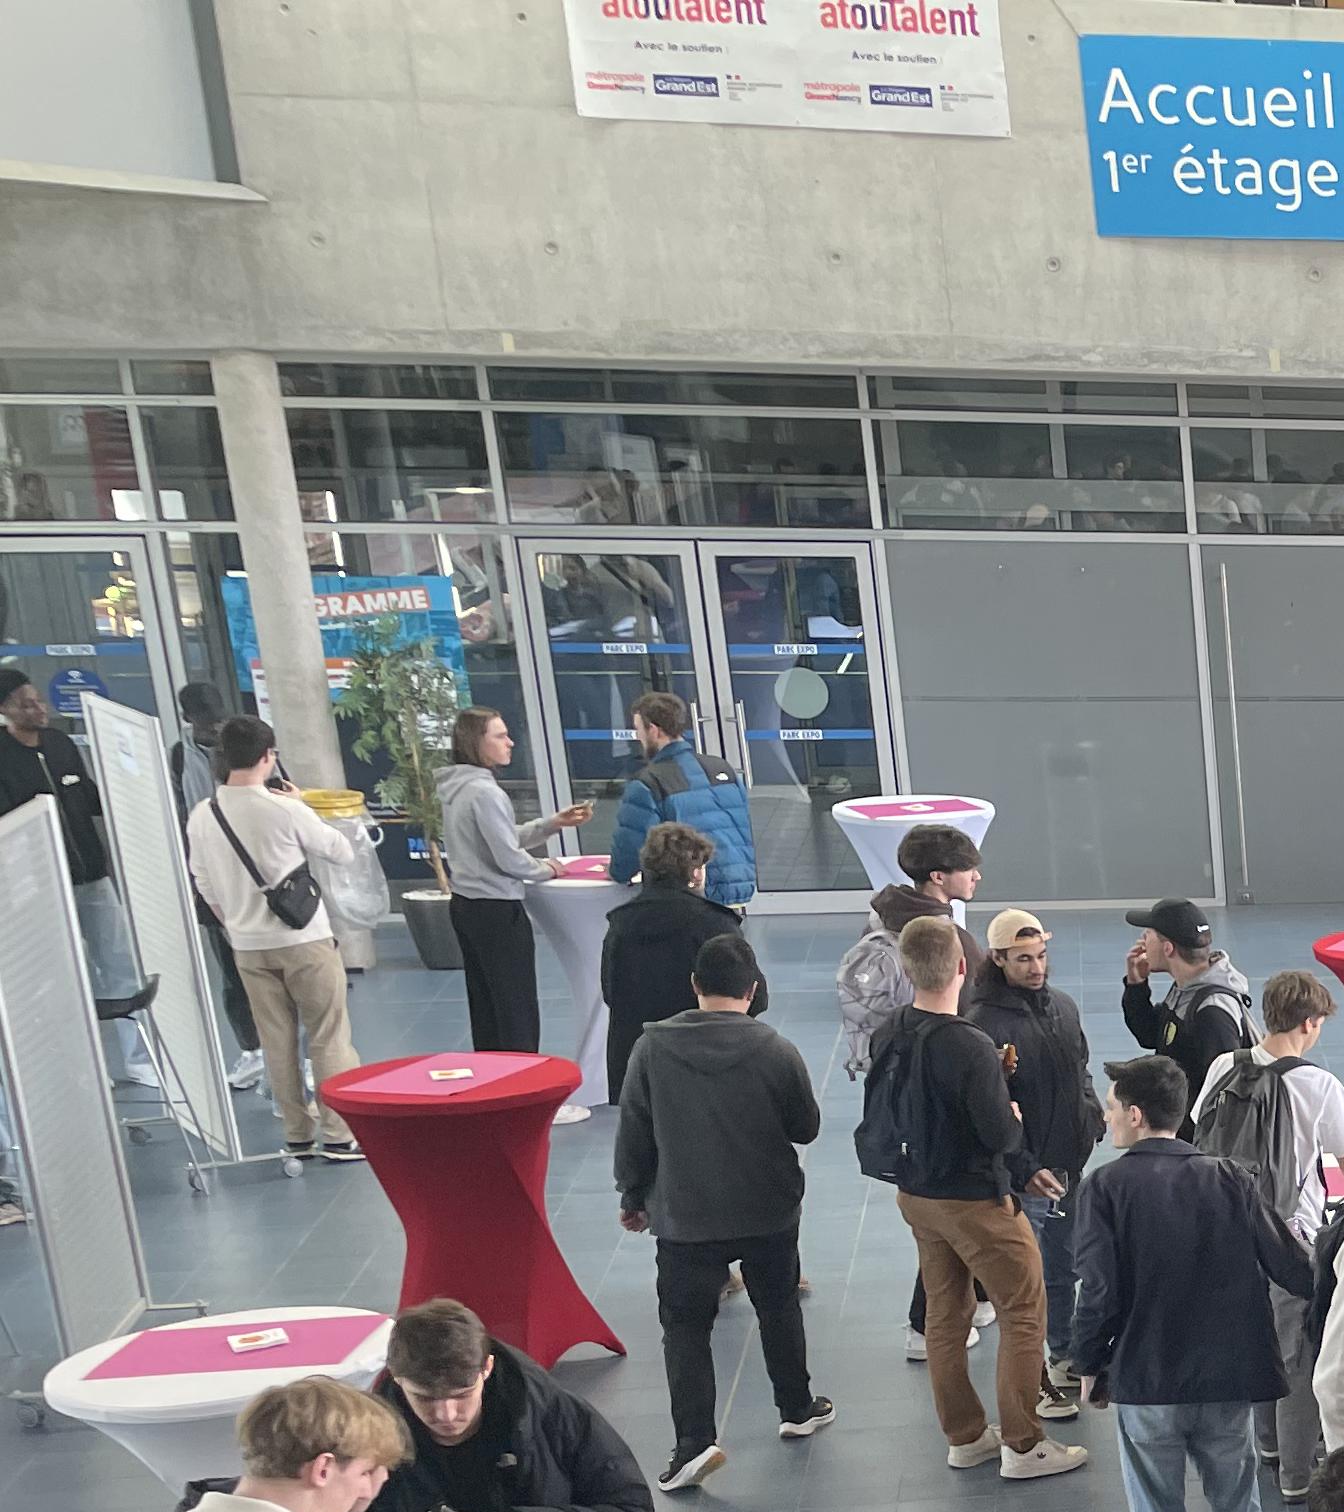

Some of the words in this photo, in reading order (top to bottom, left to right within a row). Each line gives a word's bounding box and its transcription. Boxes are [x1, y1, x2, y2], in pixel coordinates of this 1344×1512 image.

[819, 0, 981, 37] atouTalent
[634, 41, 663, 51] Avec
[668, 42, 679, 51] le
[852, 51, 880, 61] Avec
[884, 52, 894, 62] le
[1098, 67, 1335, 129] Accueil
[1103, 150, 1152, 193] 1er
[1173, 143, 1339, 212] étage
[314, 589, 428, 618] GRAMME
